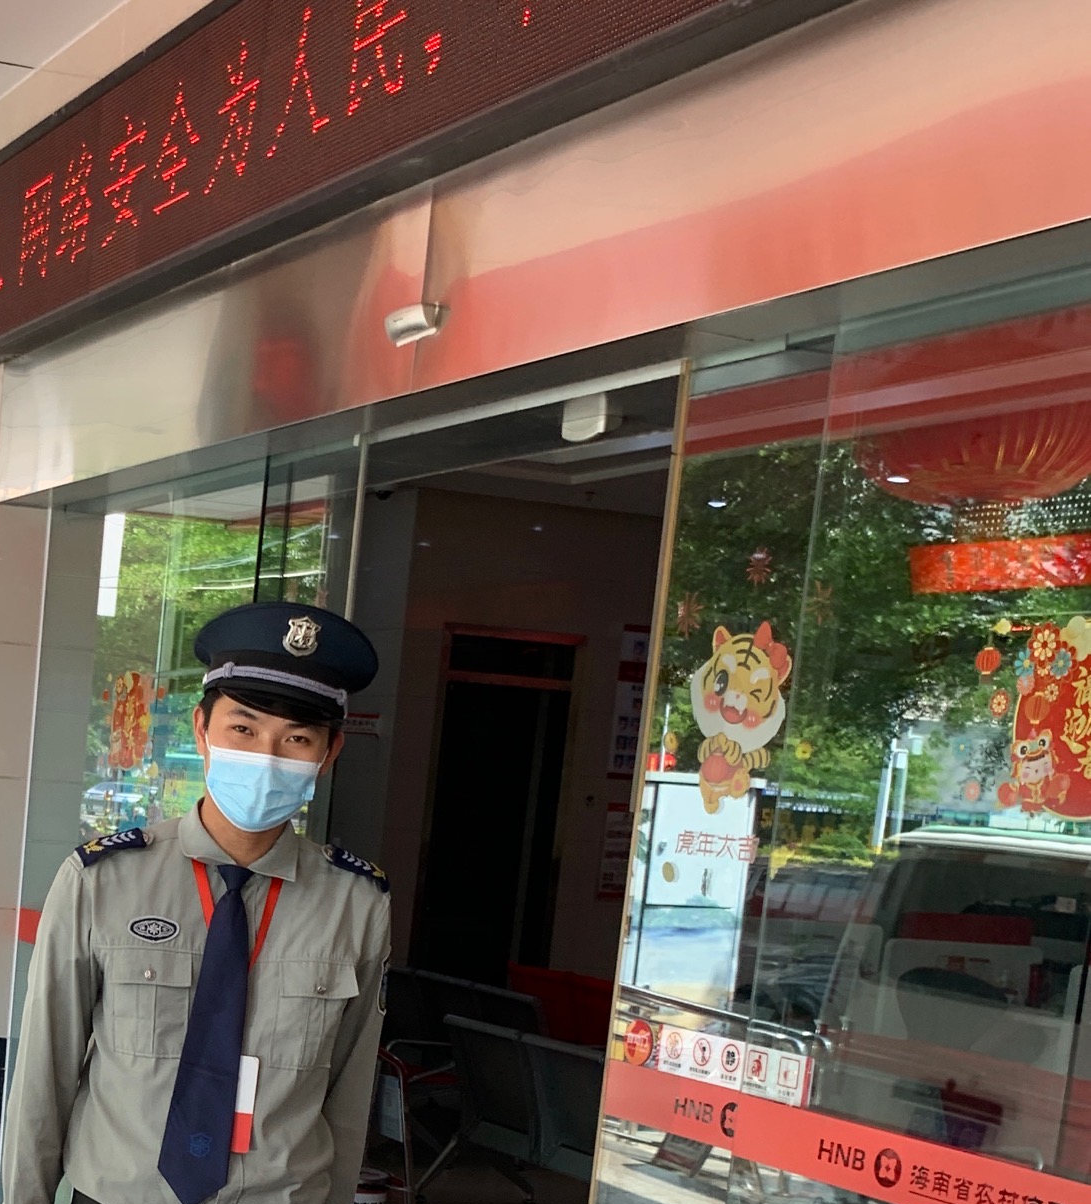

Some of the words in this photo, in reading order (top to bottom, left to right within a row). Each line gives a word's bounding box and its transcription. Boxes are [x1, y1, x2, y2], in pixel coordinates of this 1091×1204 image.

[675, 830, 757, 864] 虎年大吉
[674, 1097, 714, 1124] HNB
[818, 1138, 866, 1171] HNB
